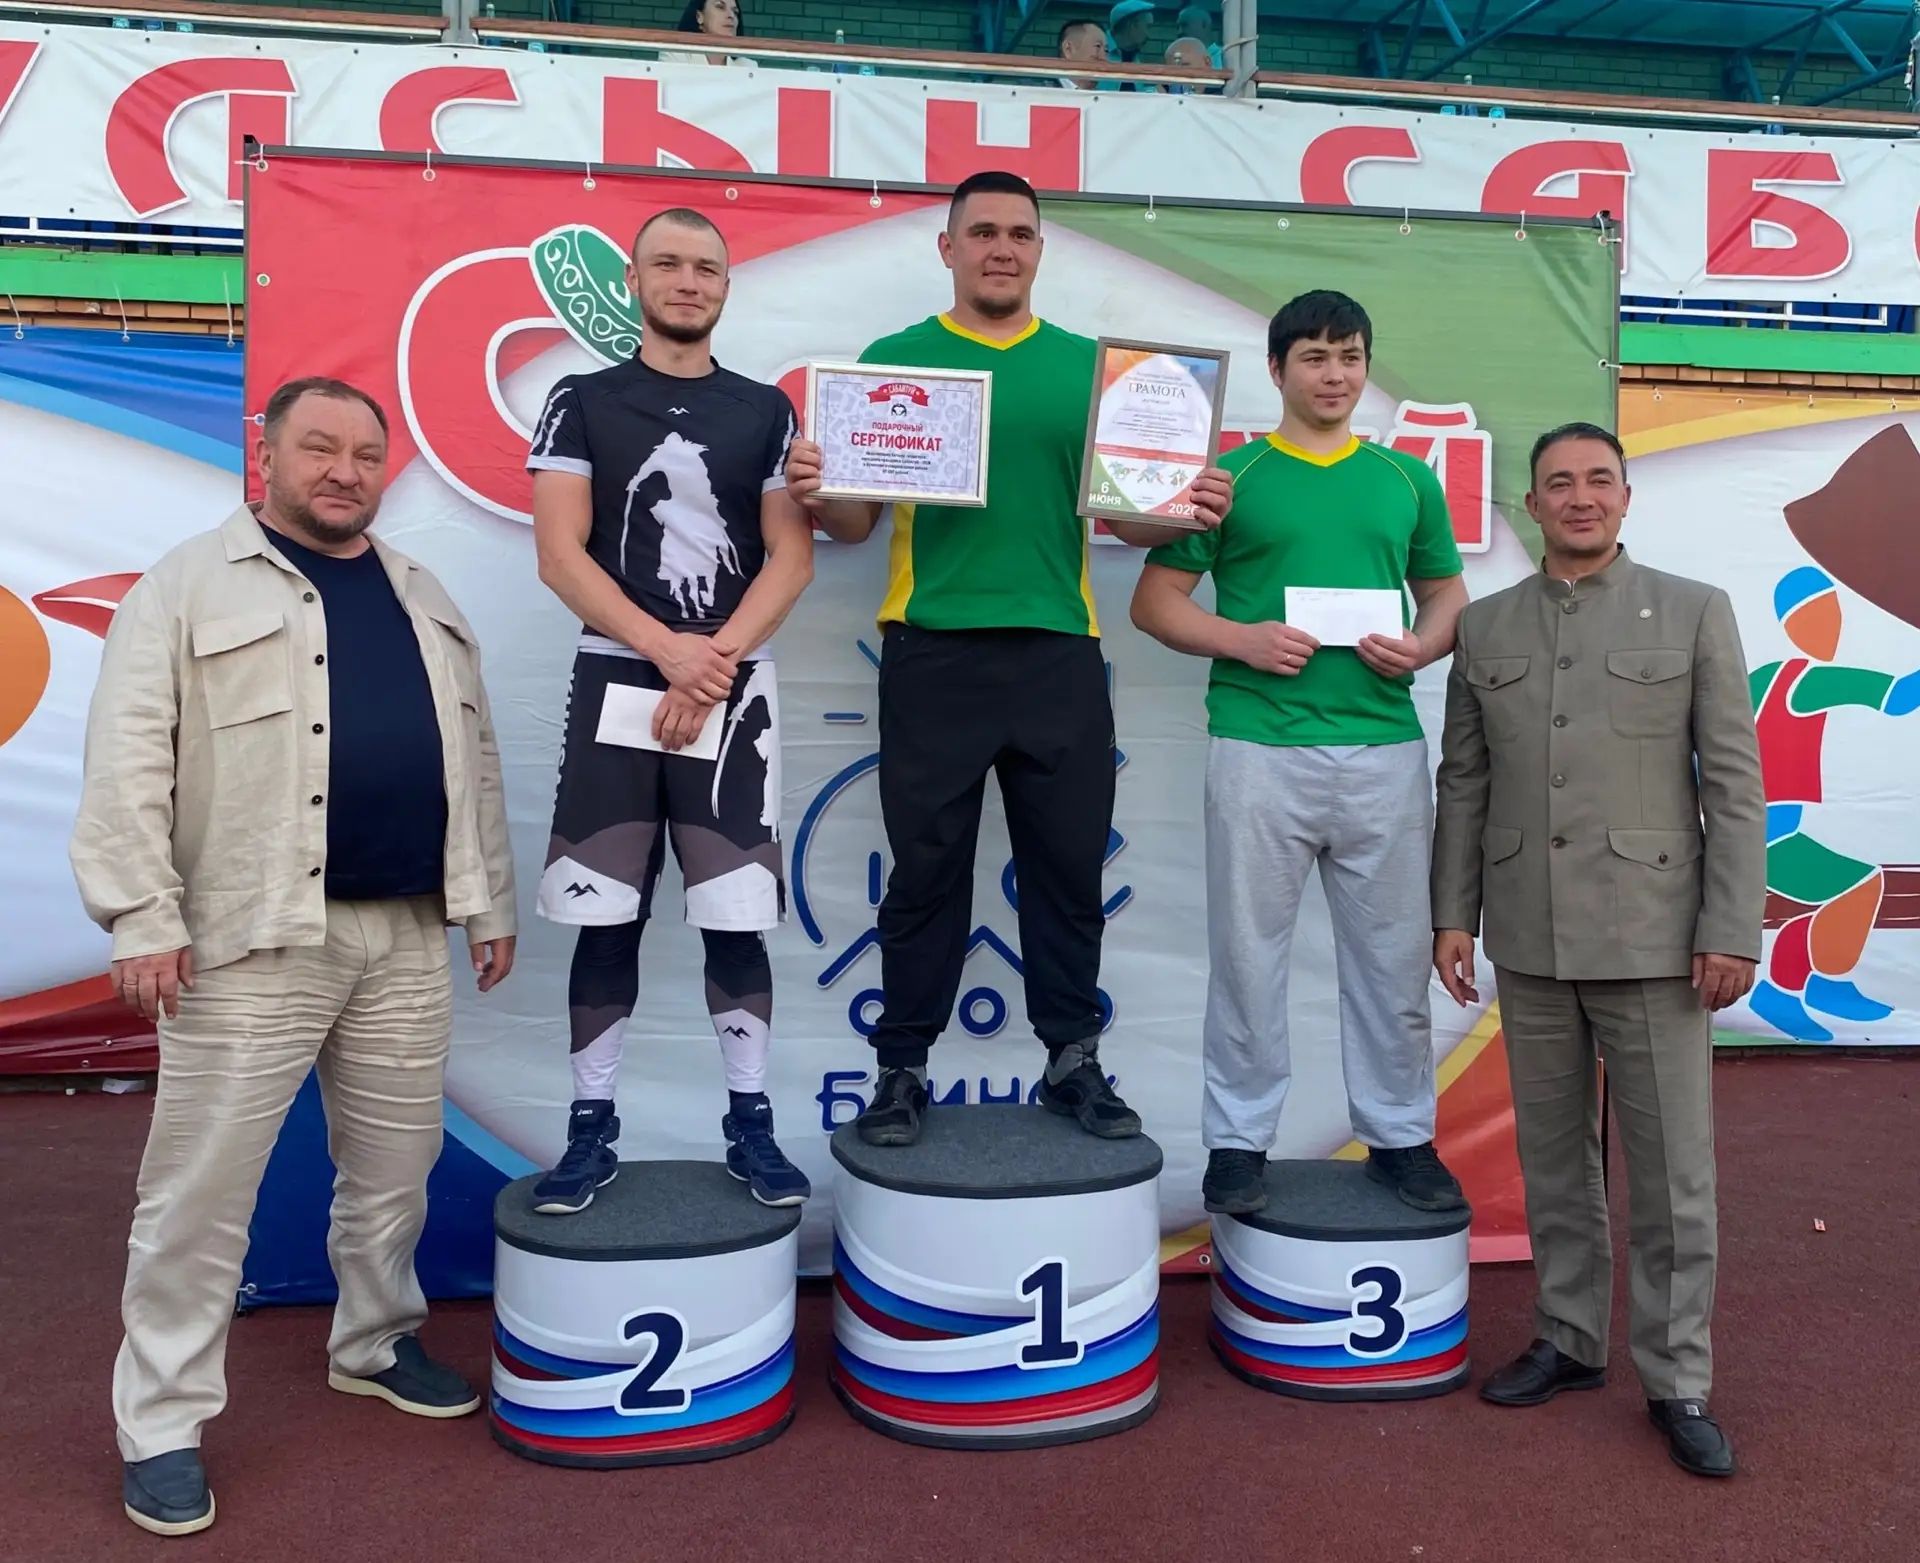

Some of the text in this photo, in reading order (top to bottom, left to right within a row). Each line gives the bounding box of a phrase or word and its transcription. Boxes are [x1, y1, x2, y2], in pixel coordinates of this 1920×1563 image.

[1300, 126, 1920, 281] САБ
[1129, 382, 1186, 398] ГРАМОТА
[851, 432, 943, 451] СЕРТИФИКАТ
[872, 421, 923, 432] ПОДАРОЧНЫЙ
[1101, 481, 1110, 493] 6
[1022, 1263, 1077, 1362] 1
[1350, 1267, 1404, 1352] 3
[621, 1313, 684, 1408] 2
